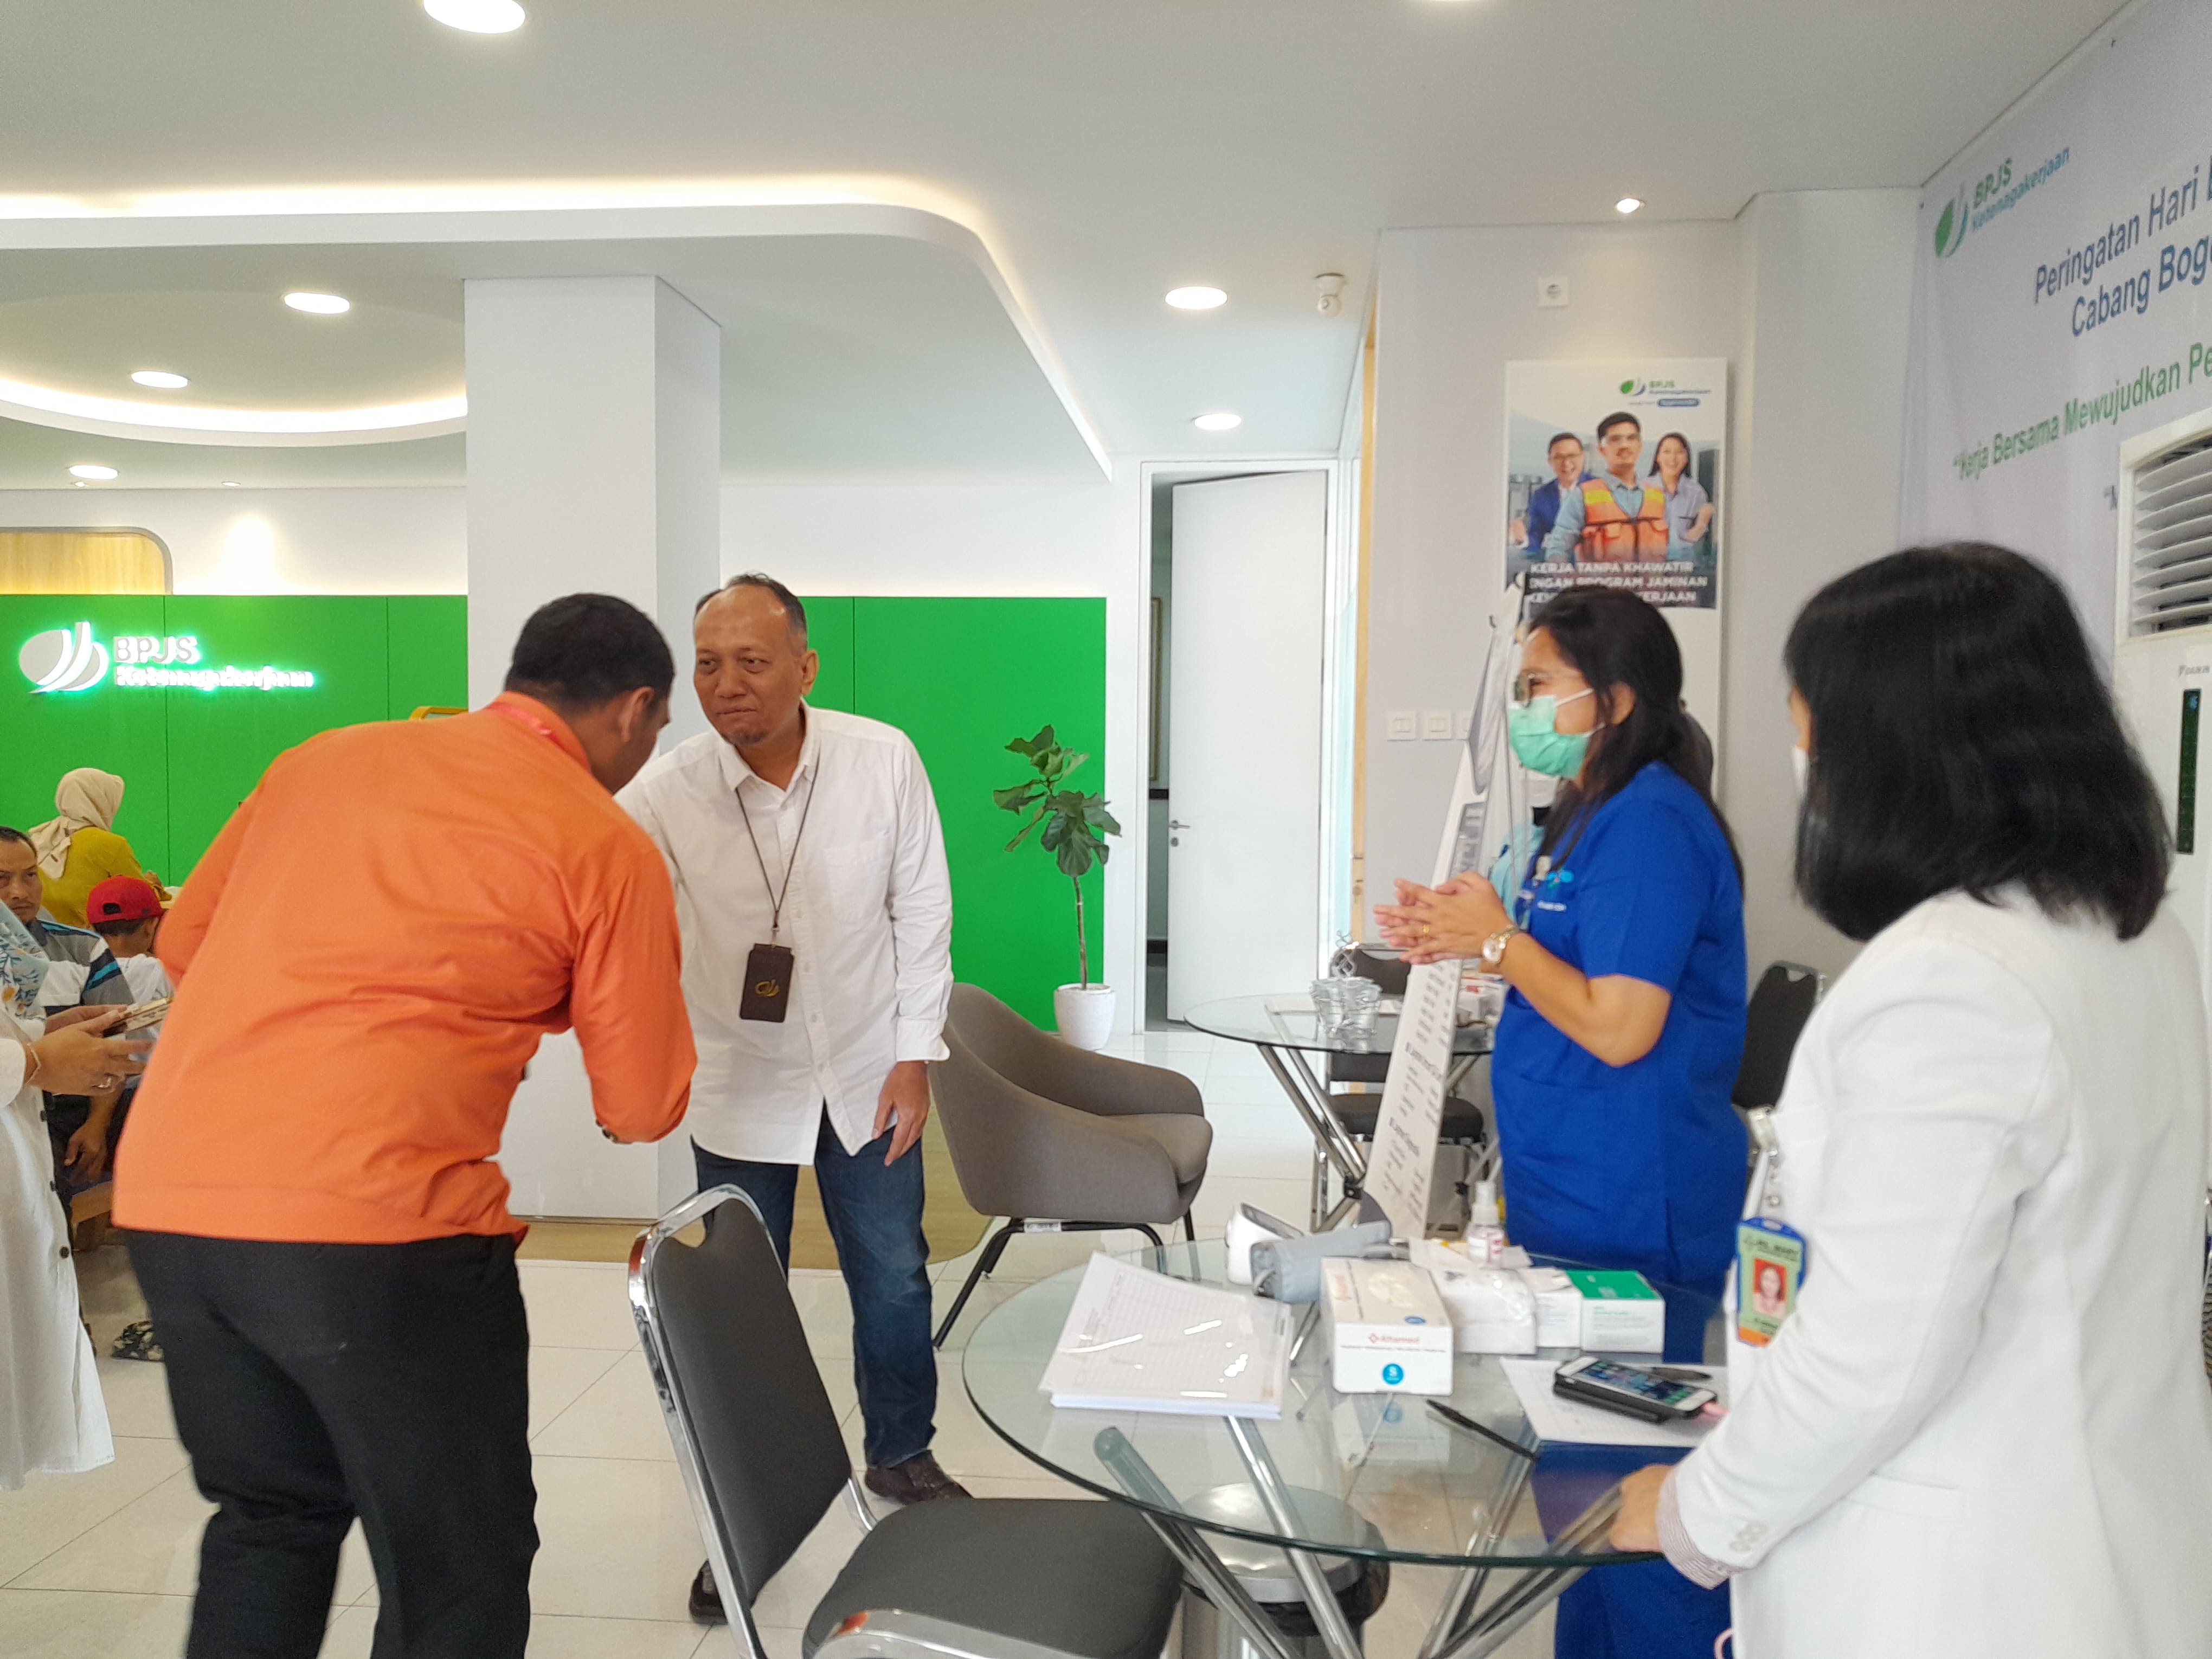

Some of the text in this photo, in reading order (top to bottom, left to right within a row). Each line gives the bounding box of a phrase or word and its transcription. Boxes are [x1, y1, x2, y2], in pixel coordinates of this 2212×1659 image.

[1973, 157, 2012, 209] BPJS
[2035, 214, 2140, 304] Peringatan
[2148, 165, 2199, 237] Hari
[2072, 235, 2212, 337] Cabang Bog
[1993, 415, 2059, 464] Bersama
[2064, 361, 2180, 435] Mewujudkan
[114, 636, 200, 664] BPJS
